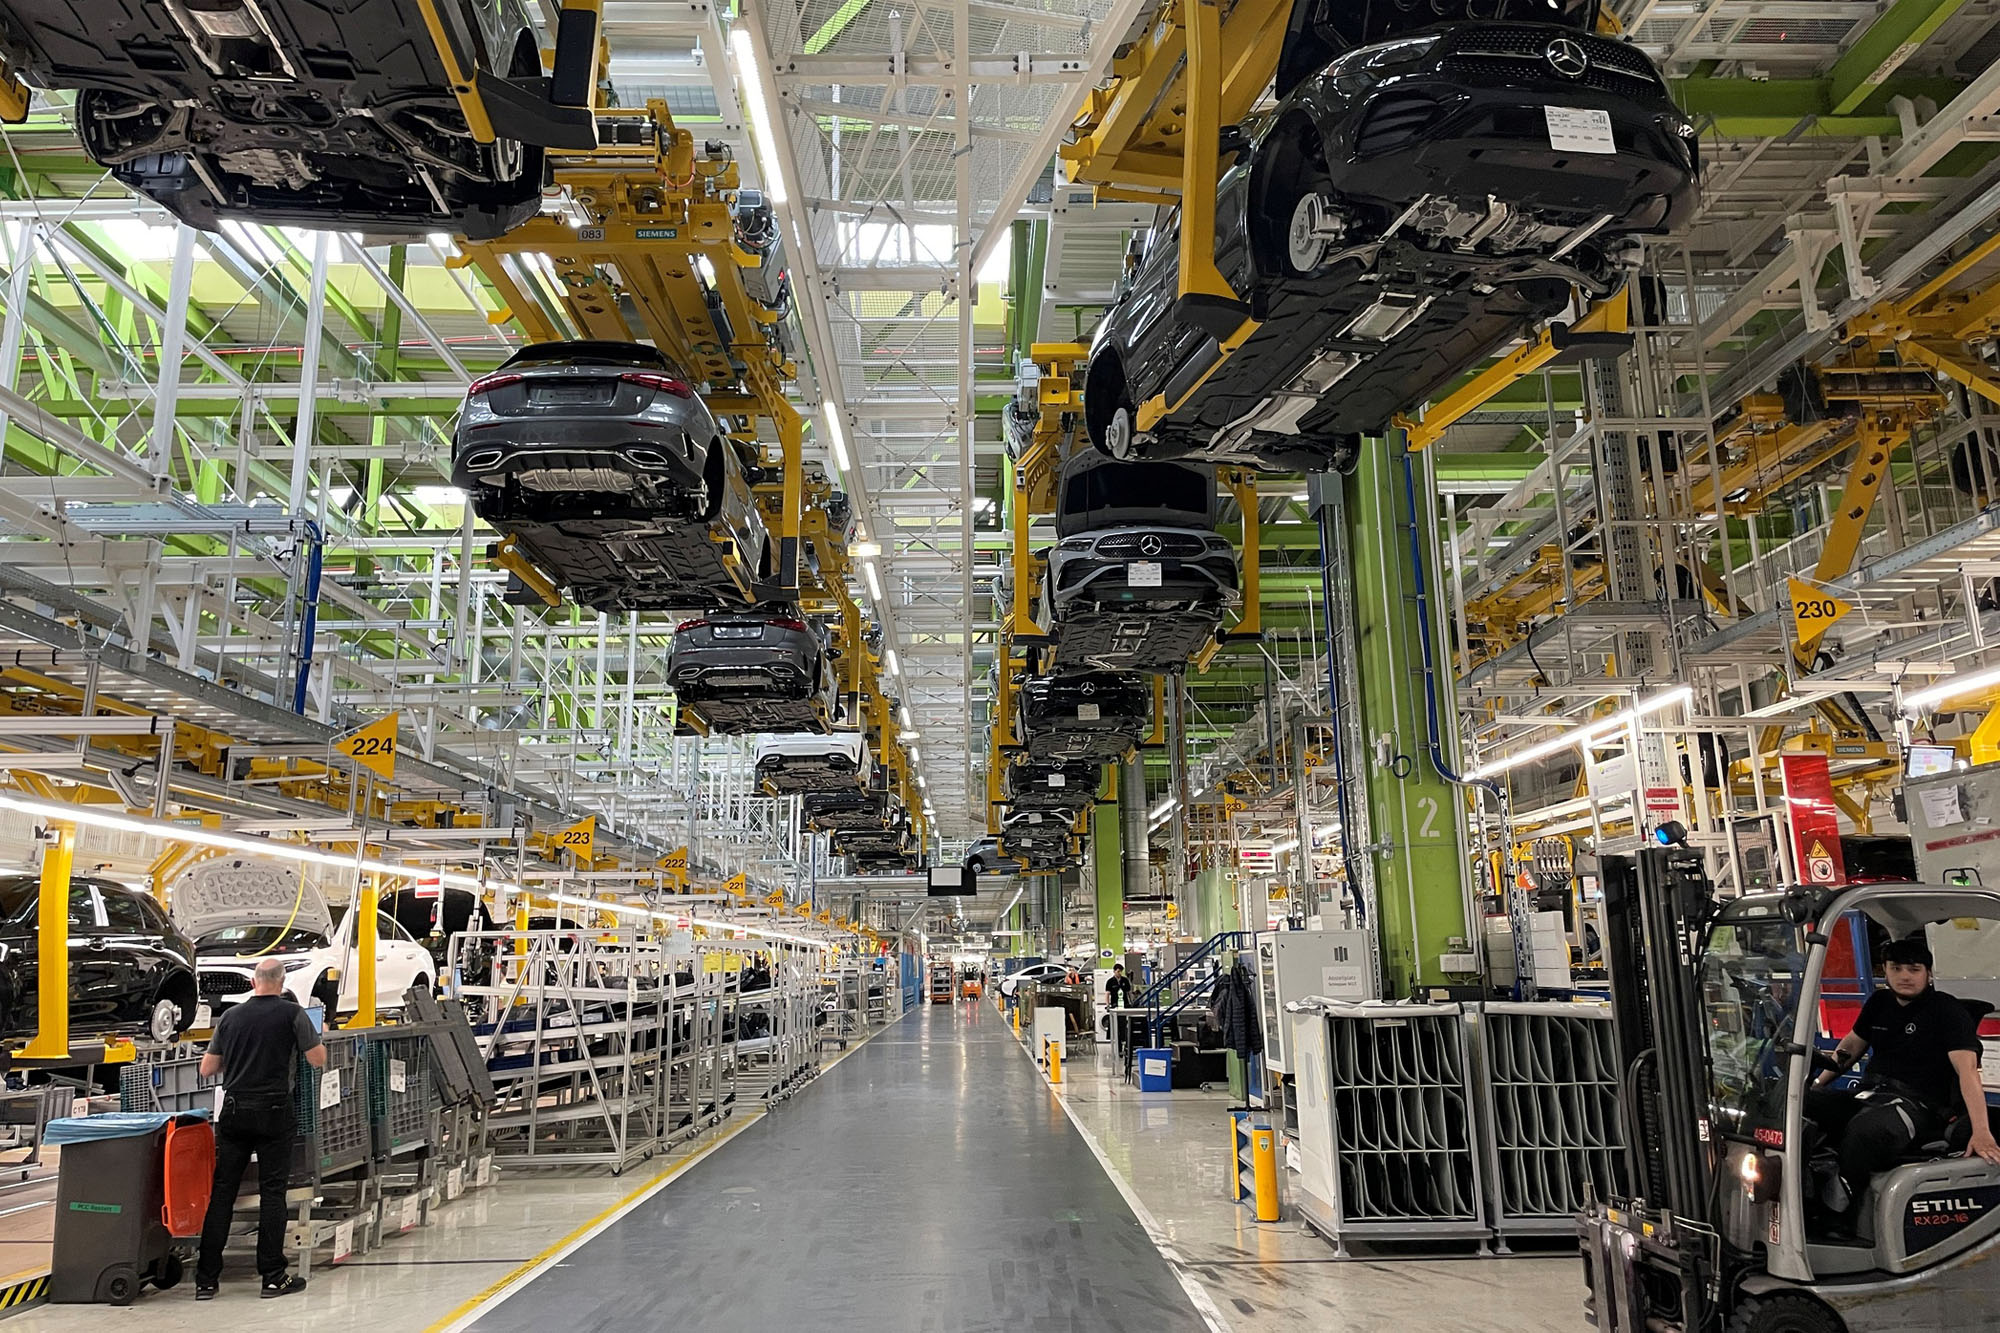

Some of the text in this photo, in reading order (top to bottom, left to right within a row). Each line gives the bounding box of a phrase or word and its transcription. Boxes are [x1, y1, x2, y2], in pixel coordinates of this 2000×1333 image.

[582, 230, 602, 240] 083
[637, 230, 676, 238] SIEMENS
[1796, 600, 1836, 619] 230
[352, 737, 393, 755] 224
[1304, 758, 1318, 767] 32
[1417, 796, 1440, 838] 2
[563, 832, 590, 844] 223
[664, 858, 685, 868] 222
[728, 881, 744, 890] 221
[768, 896, 782, 904] 220
[1107, 915, 1115, 929] 2
[1676, 914, 1690, 966] STILL
[1912, 1198, 1983, 1214] STILL
